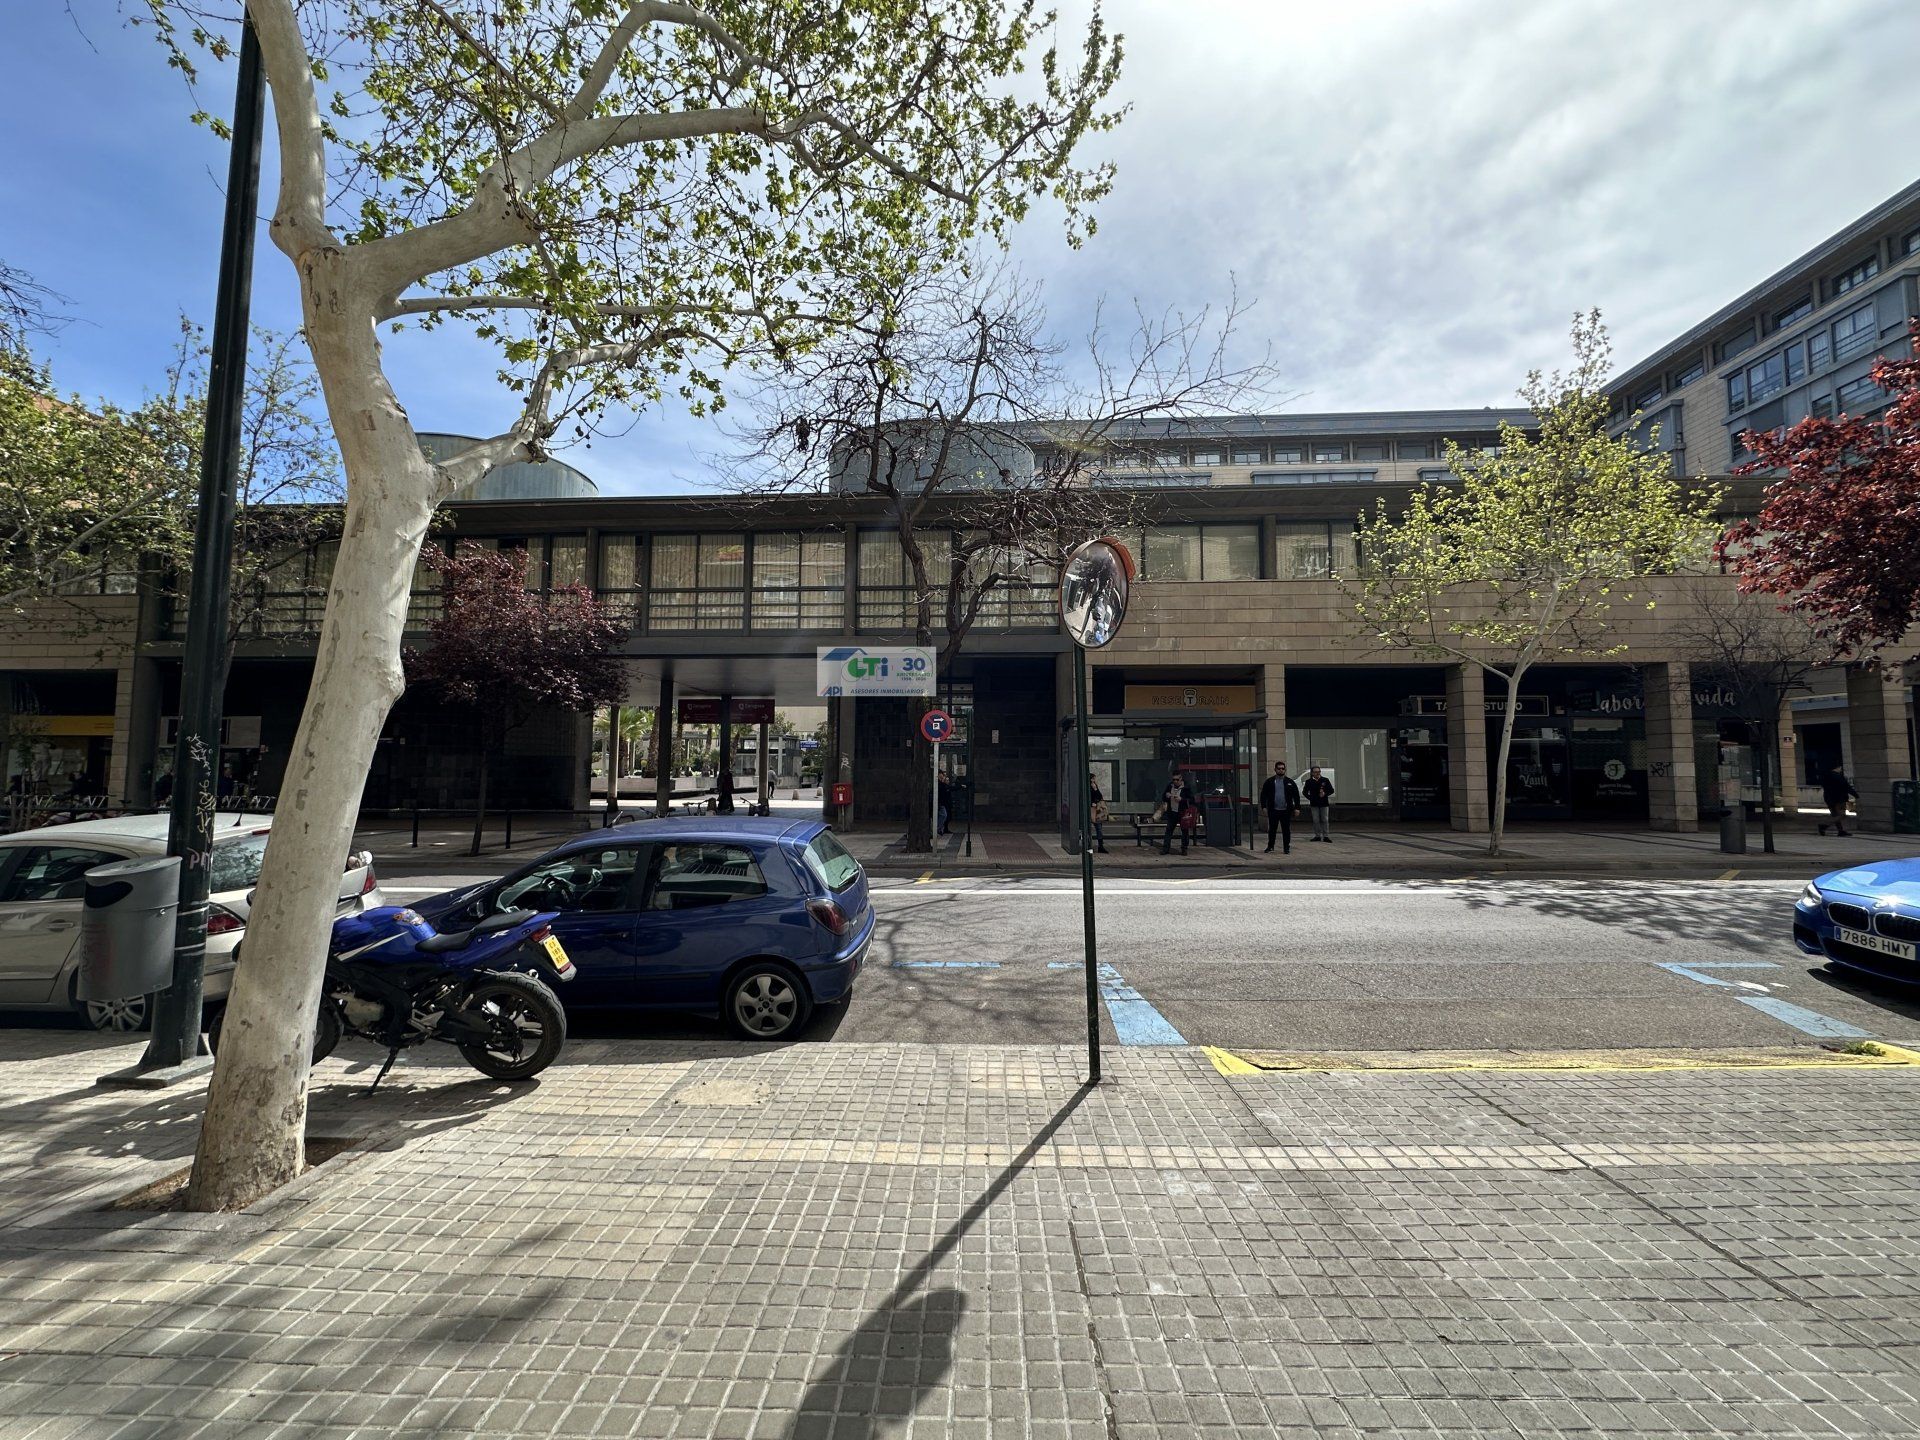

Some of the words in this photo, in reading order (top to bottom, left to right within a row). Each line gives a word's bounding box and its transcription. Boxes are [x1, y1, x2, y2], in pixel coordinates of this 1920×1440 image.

[1484, 701, 1523, 711] STUO
[1843, 929, 1877, 948] 7886
[1882, 940, 1910, 956] HMY
